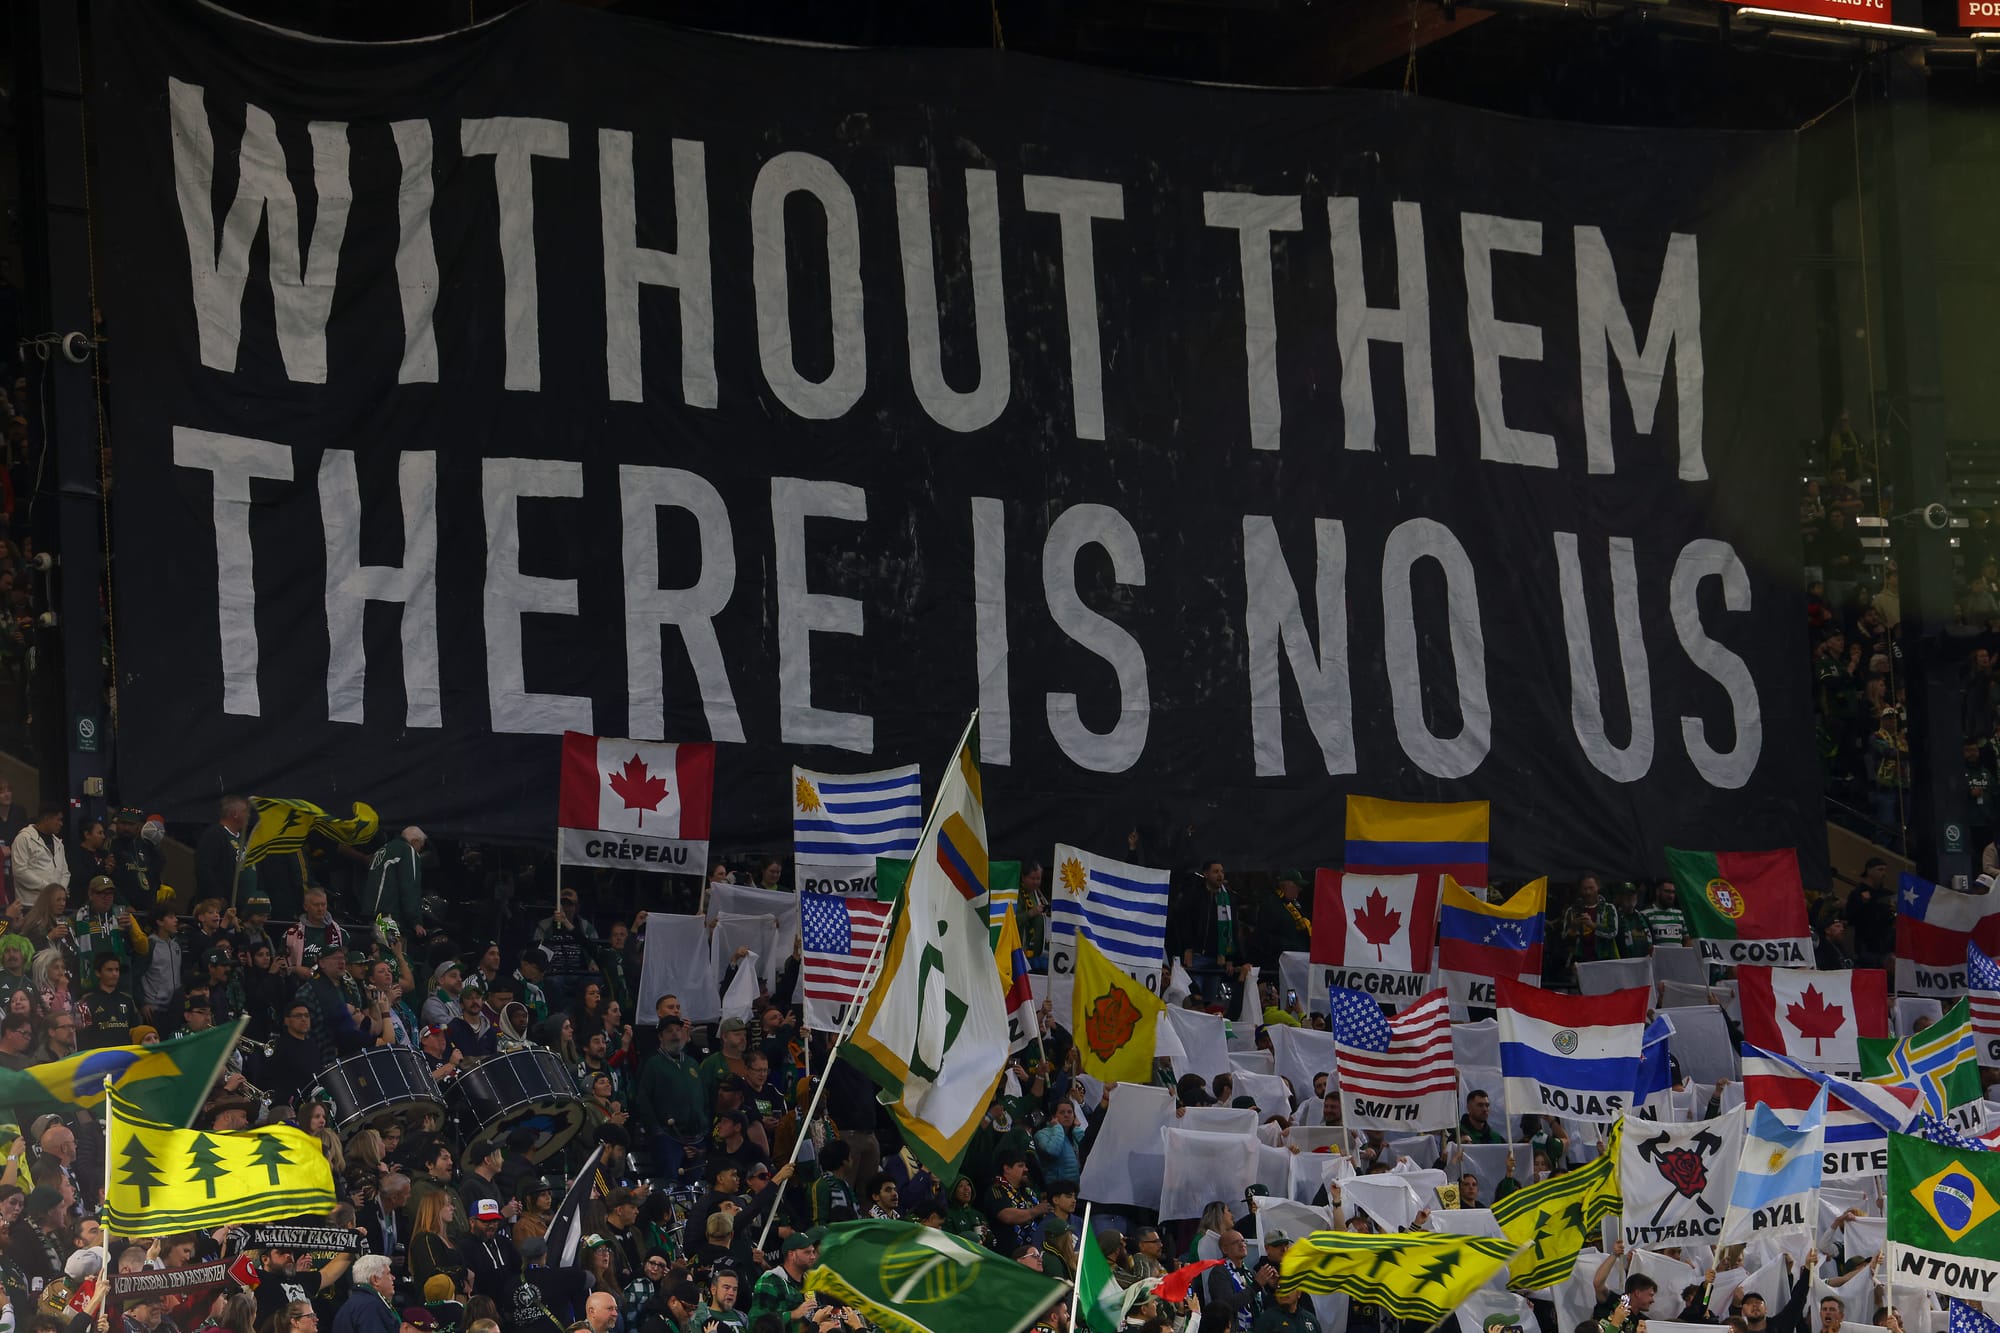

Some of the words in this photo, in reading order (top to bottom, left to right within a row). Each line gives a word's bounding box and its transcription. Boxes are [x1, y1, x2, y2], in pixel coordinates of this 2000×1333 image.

[169, 77, 1124, 442] WITHOUT
[1203, 190, 1709, 482] THEM
[172, 426, 874, 755] THERE
[972, 496, 1151, 774] IS
[1243, 514, 1492, 780] NO
[1554, 531, 1763, 790] US
[585, 838, 688, 865] CRÉPEAU
[1700, 941, 1723, 960] DA
[1730, 942, 1805, 961] COSTA
[1324, 969, 1424, 996] MCGRAW
[1354, 1098, 1420, 1121] SMITH
[1539, 1085, 1623, 1116] ROJAS
[254, 1228, 307, 1243] AGAINST
[307, 1230, 358, 1248] FASCISM
[114, 1277, 132, 1295] KEIN
[132, 1273, 170, 1292] FUSSBALL
[168, 1271, 186, 1288] DEN
[185, 1263, 226, 1286] FASCHISTEN
[1895, 1249, 1998, 1292] NTONY
